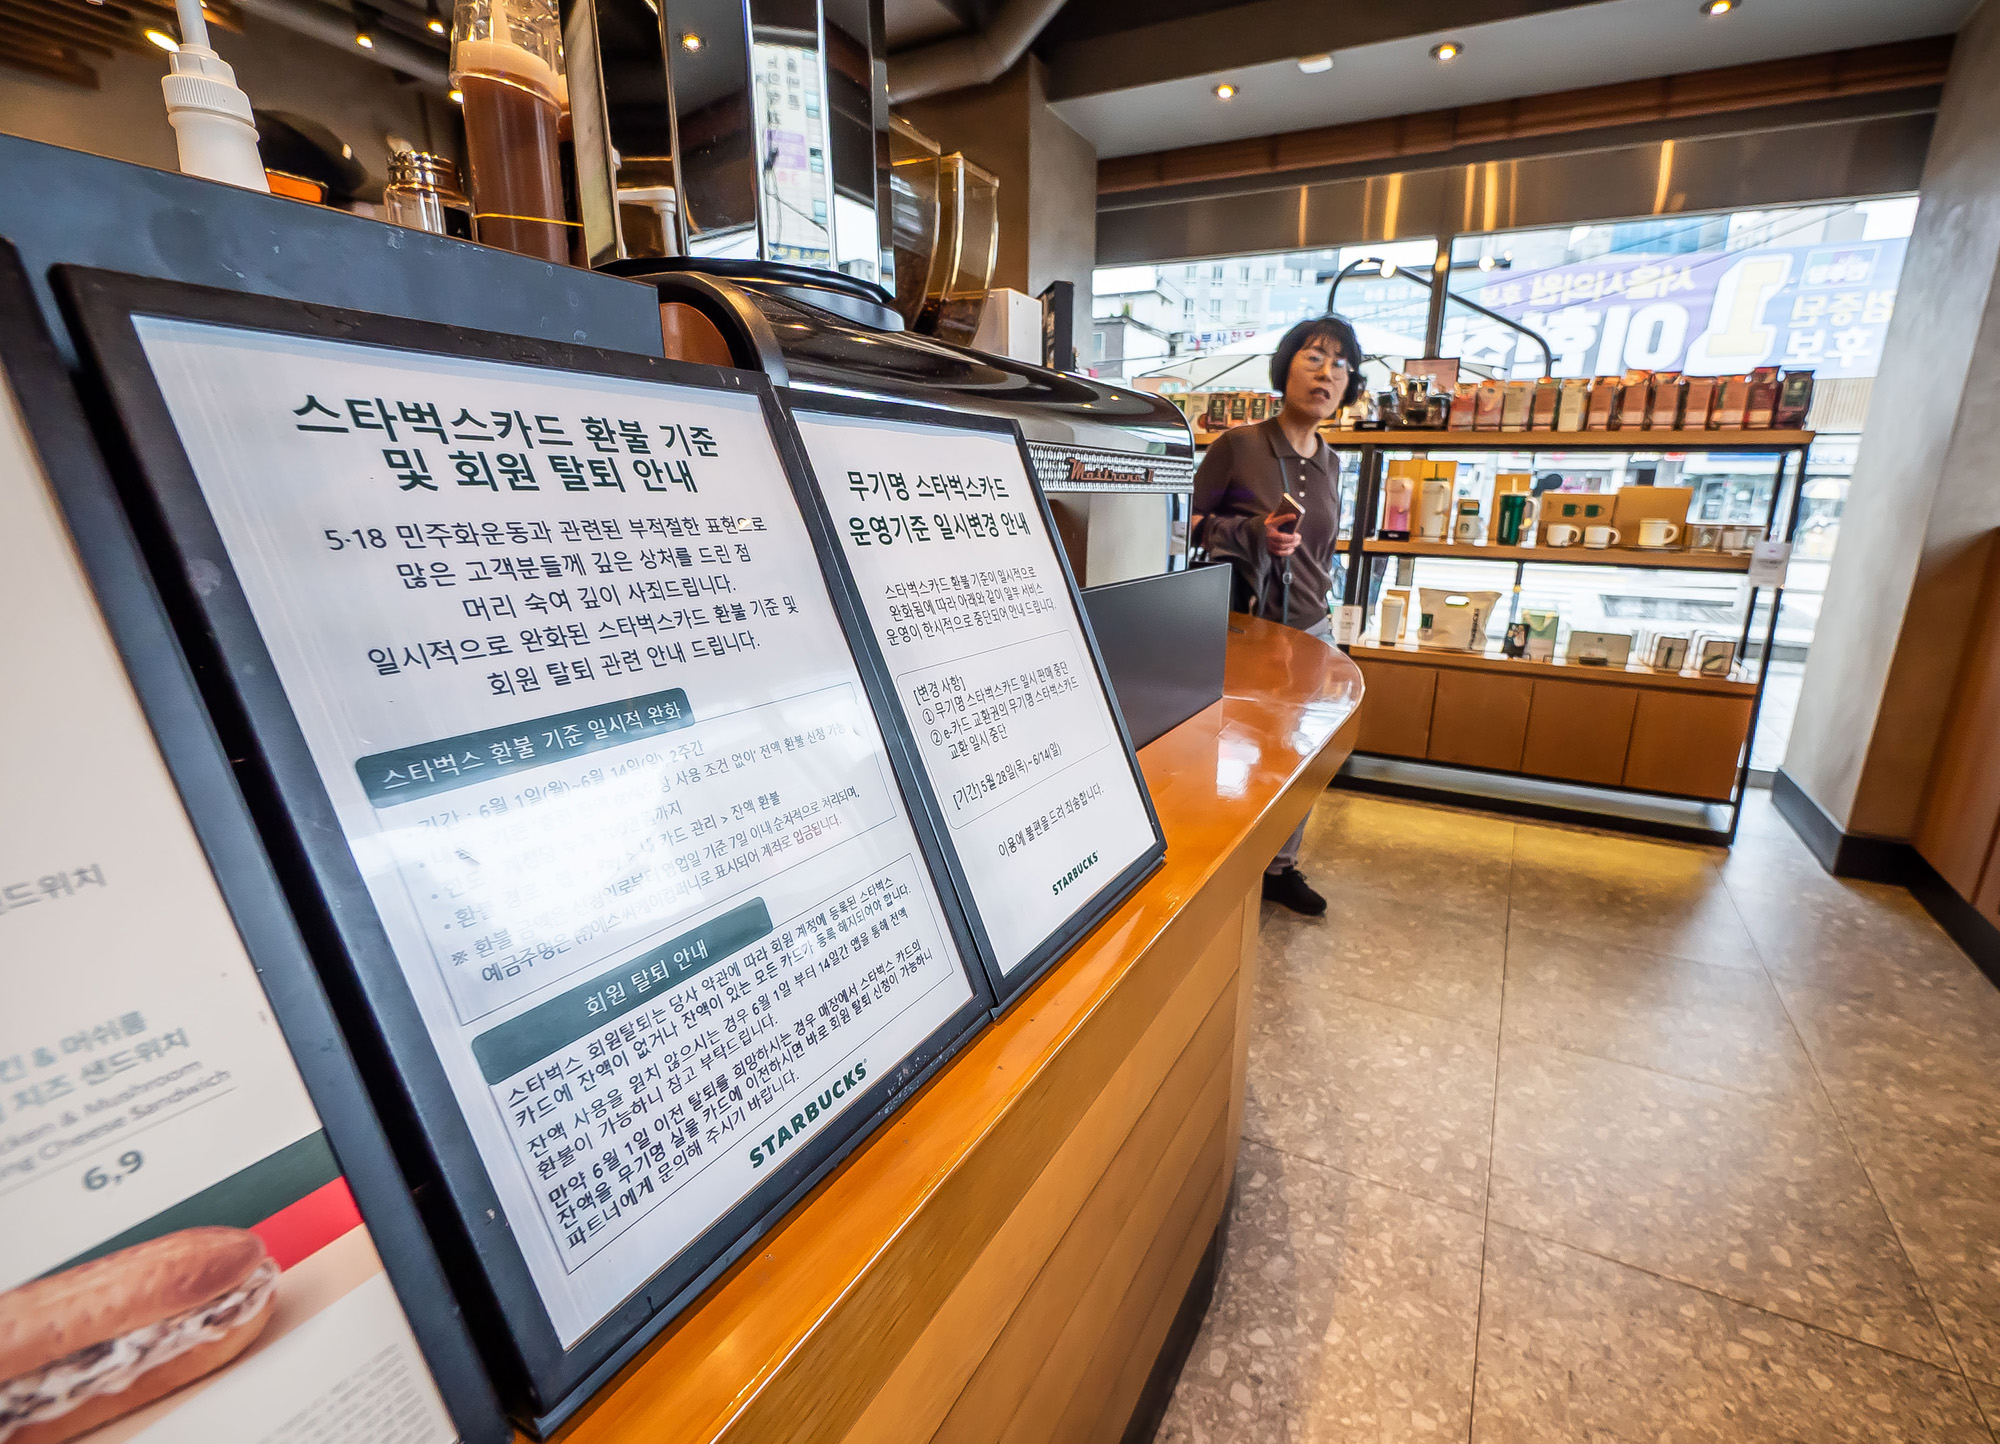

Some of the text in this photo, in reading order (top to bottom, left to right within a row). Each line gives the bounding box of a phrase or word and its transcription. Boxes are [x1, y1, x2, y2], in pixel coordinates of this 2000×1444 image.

[291, 394, 719, 457] 스타벅스카드 환불 기준
[380, 447, 698, 493] 및 회원 탈퇴 안내
[846, 470, 1010, 502] 무기명 스타벅스카드
[393, 519, 552, 549] 민주화운동과
[557, 517, 623, 542] 관련된
[627, 515, 701, 539] 부적절한
[704, 514, 768, 535] 표현으로
[848, 511, 1031, 546] 운영기준 일시변경 안내
[394, 542, 752, 589] 많은 고객분들께 깊은 상처를 드린 점
[884, 565, 1037, 600] 스타벅스카드 환불 기준이 일시적으로
[460, 573, 736, 621] 머리 숙여 깊이 사죄드립니다.
[885, 596, 1057, 646] 운영이 한시적으로 중단되어 안내 드립니다.
[888, 582, 1044, 622] 완화됨에 따라 아래와 같이 일부 서비스
[366, 594, 799, 676] 일시적으로 완화된 스타벅스카드 환불 기준 및
[486, 629, 760, 696] 회원 탈퇴 관련 안내 드립니다.
[912, 673, 966, 706] [변경 사항]
[933, 659, 1069, 719] 무기명 스타벅스카드 일시 판매 중단
[942, 675, 1079, 739] e-카드 교환권의 무기명 스타벅스카드
[383, 700, 687, 789] 스타벅스 환불 기준 일시적 완화
[947, 722, 1008, 760] 교환 일시 중단
[951, 781, 983, 811] [기간]
[979, 772, 997, 793] 5월
[997, 781, 1104, 857] 이용에 불편을 드려 죄송합니다.
[0, 863, 107, 916] 드위치
[1051, 850, 1098, 896] STARBUCKS
[507, 876, 894, 1109] 스타벅스 회원탈퇴는 당사 약관에 따라 회원 계정에 등록된 스타벅스
[583, 938, 708, 1017] 회원 탈퇴 안내
[513, 960, 779, 1128] 카드에 잔액이 없거나 잔액이 있는 모든
[524, 905, 909, 1159] 잔액 사용을 원치 않으시는 경우 6월 1일 부터 14일간 앱을 전액
[534, 1011, 778, 1181] 환불이 가능하니 참고 부탁드립니다.
[547, 937, 922, 1209] 만약 6월 1일 이전 탈퇴를 희망하시는 경우 매장에서 스타벅스 카드의
[555, 946, 933, 1230] 잔액을 무기명 실물 카드에 이전하시면 바로 회원 탈퇴 신청이 가능하니
[748, 1061, 867, 1169] STARBUCKS
[564, 1067, 799, 1250] 파트너에게 문의해 주시기 바랍니다.
